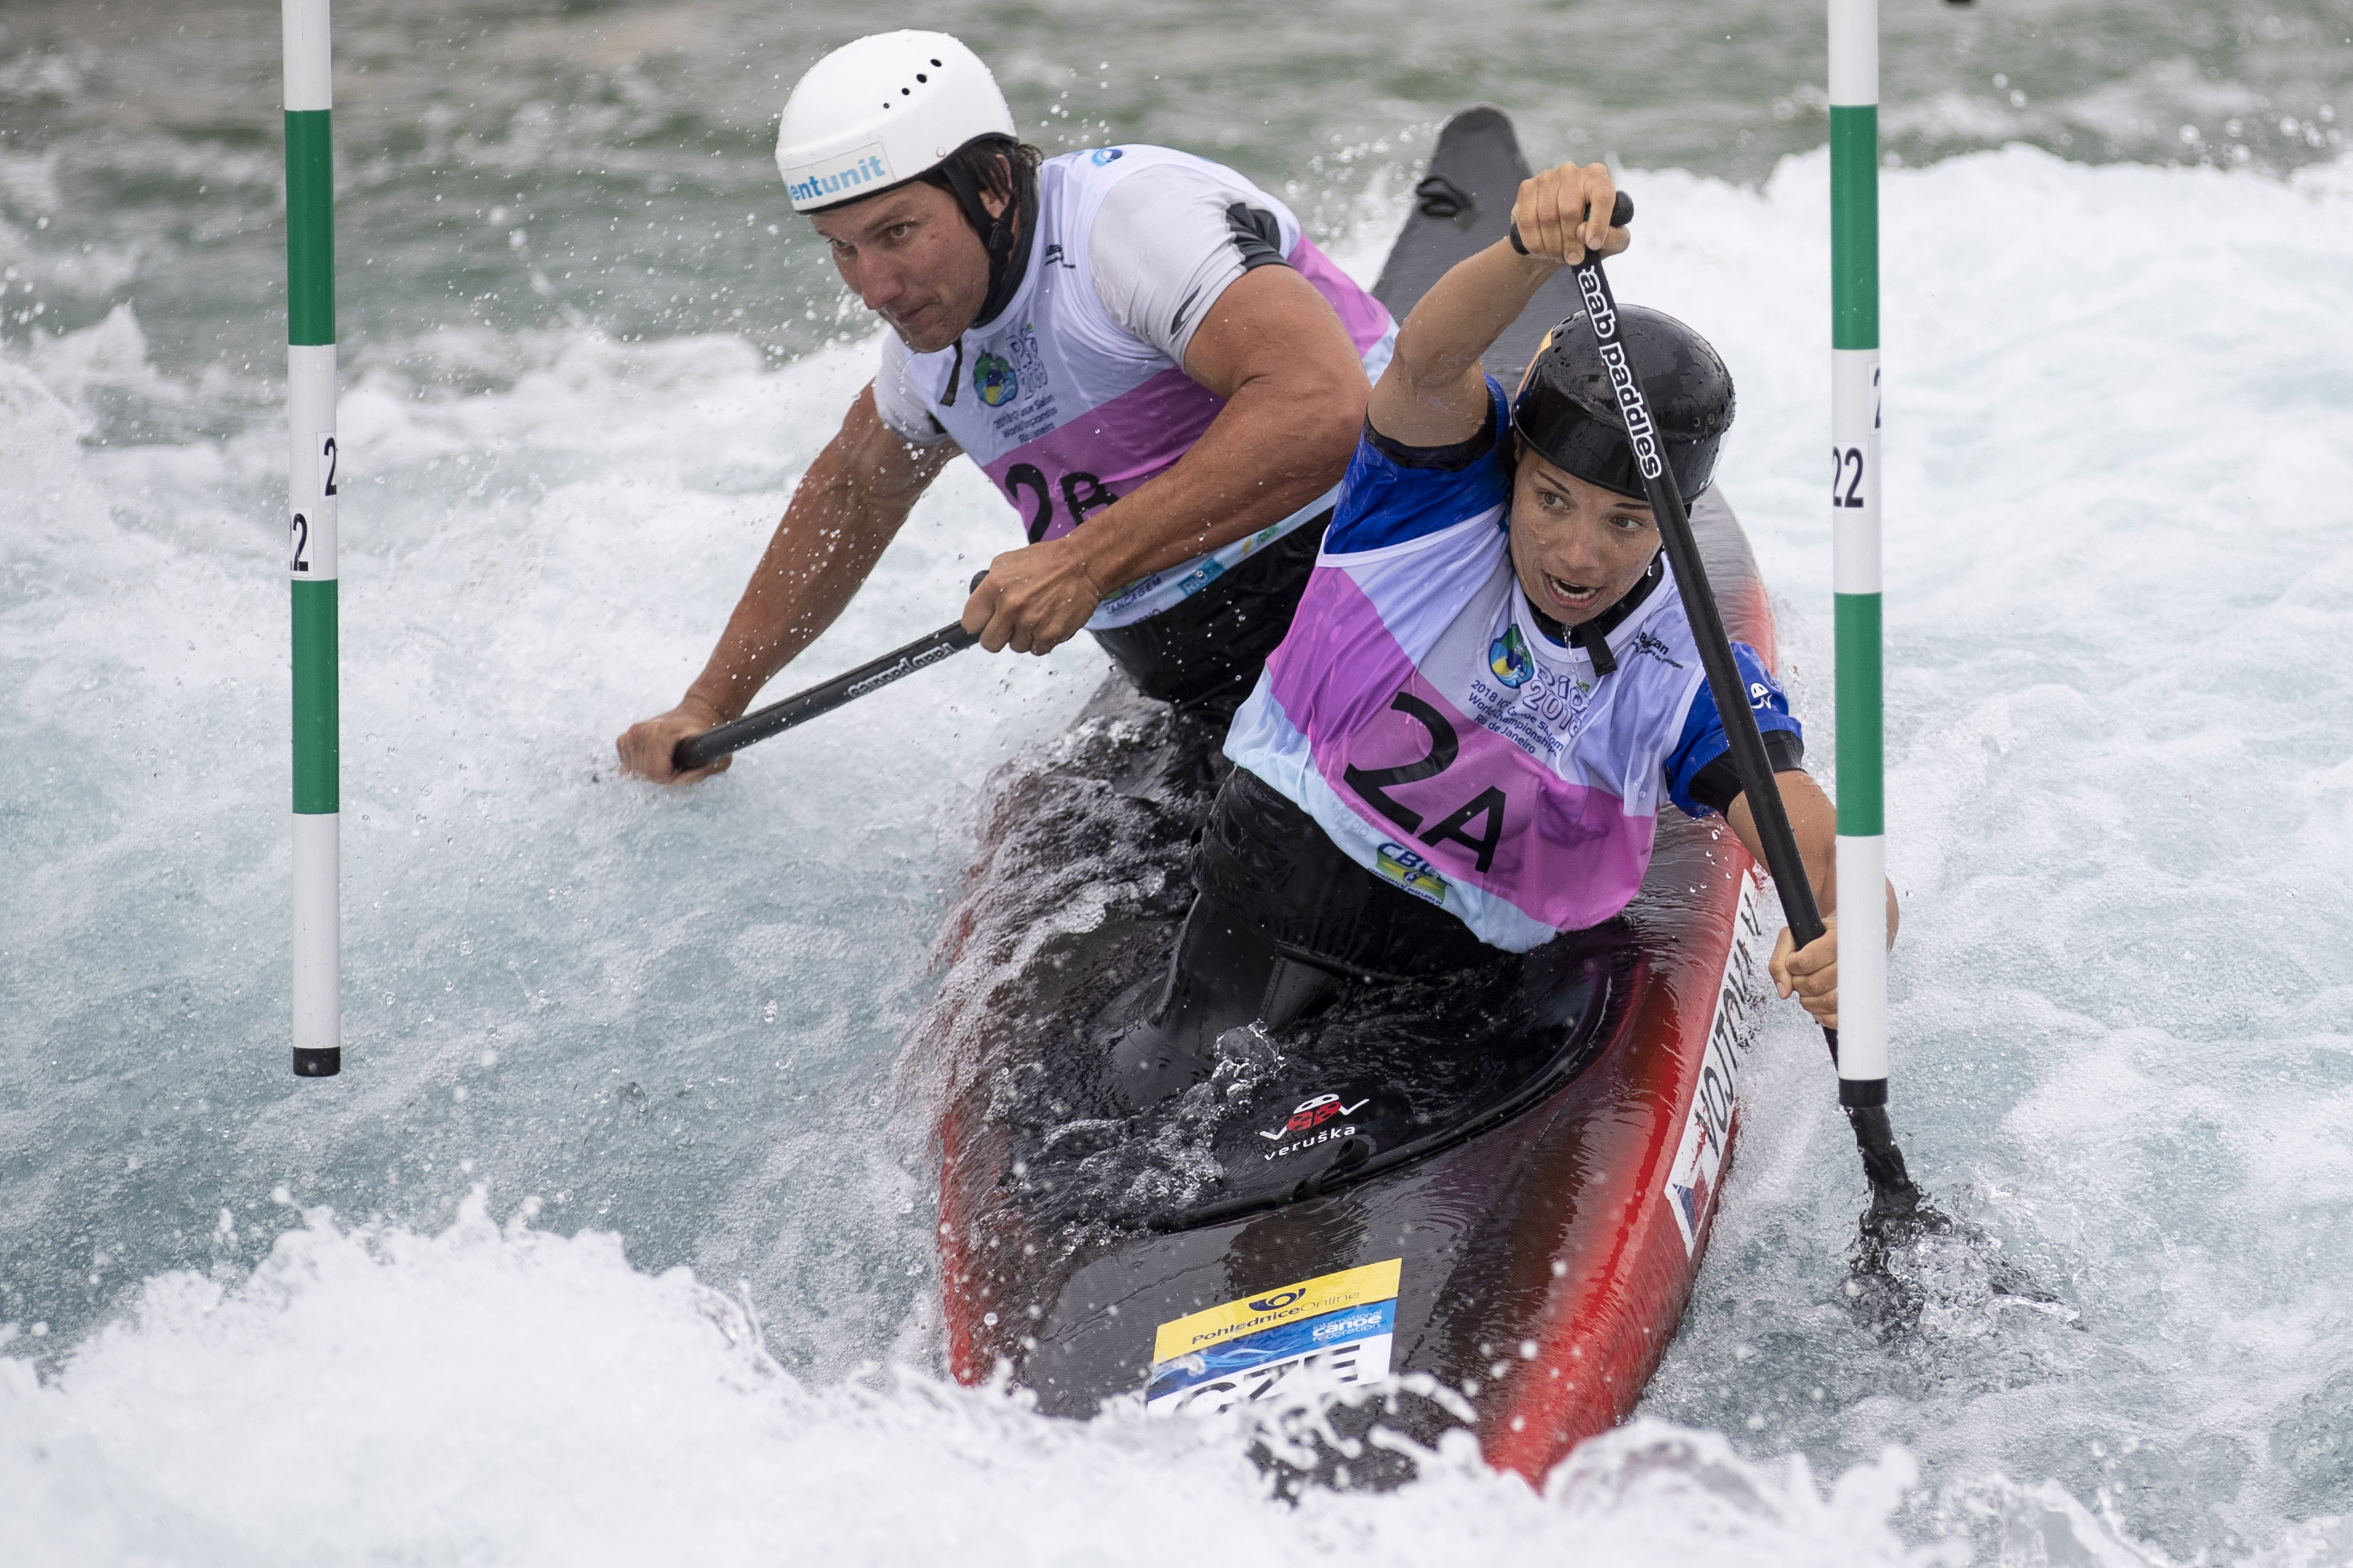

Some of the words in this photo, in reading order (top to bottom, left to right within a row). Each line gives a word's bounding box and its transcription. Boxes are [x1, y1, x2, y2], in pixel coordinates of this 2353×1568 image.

[785, 155, 886, 202] entunit
[1578, 265, 1617, 338] aab
[1599, 341, 1663, 480] paddles
[1833, 446, 1864, 508] 22
[1005, 462, 1121, 546] 2B
[290, 513, 309, 572] 2
[1468, 692, 1495, 716] World
[1471, 679, 1499, 703] 2018
[1488, 721, 1502, 733] de
[1500, 728, 1536, 755] Janeiro
[1343, 690, 1508, 874] 2A
[1264, 1126, 1356, 1161] veruška
[1191, 1291, 1360, 1345] PohledniceOnline
[1312, 1315, 1382, 1337] canoe
[1313, 1309, 1382, 1330] international
